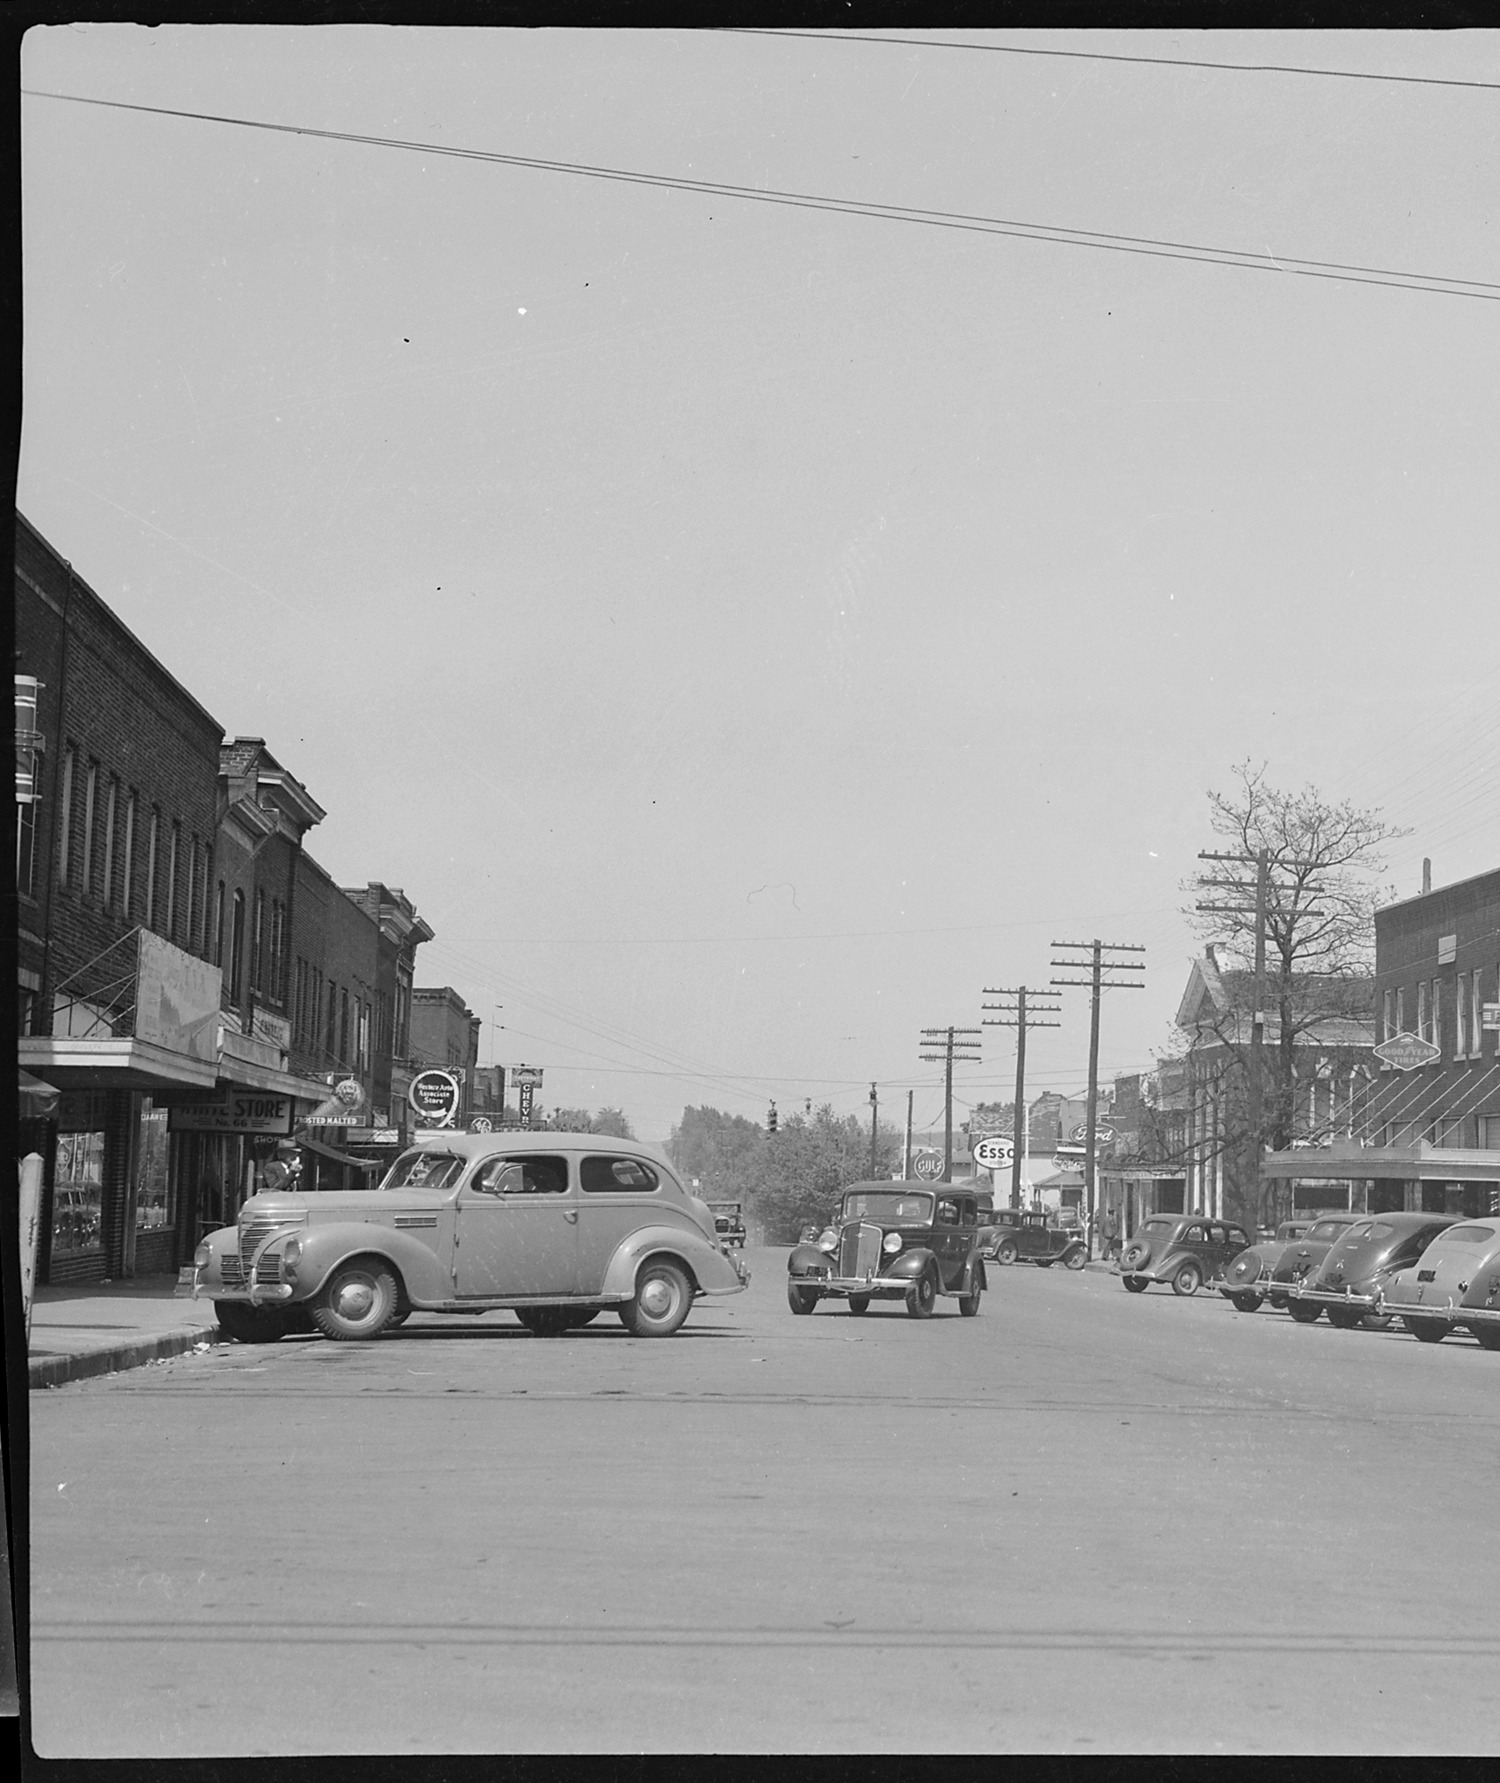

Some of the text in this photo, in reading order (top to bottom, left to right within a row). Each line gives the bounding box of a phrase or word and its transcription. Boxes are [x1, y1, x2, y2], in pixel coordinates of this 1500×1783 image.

[422, 1097, 444, 1105] Store
[234, 1099, 286, 1119] STORE
[233, 1119, 248, 1128] 66
[294, 1116, 357, 1125] FROSTED MALTED
[1076, 1127, 1113, 1141] Frd
[917, 1160, 942, 1173] GULF
